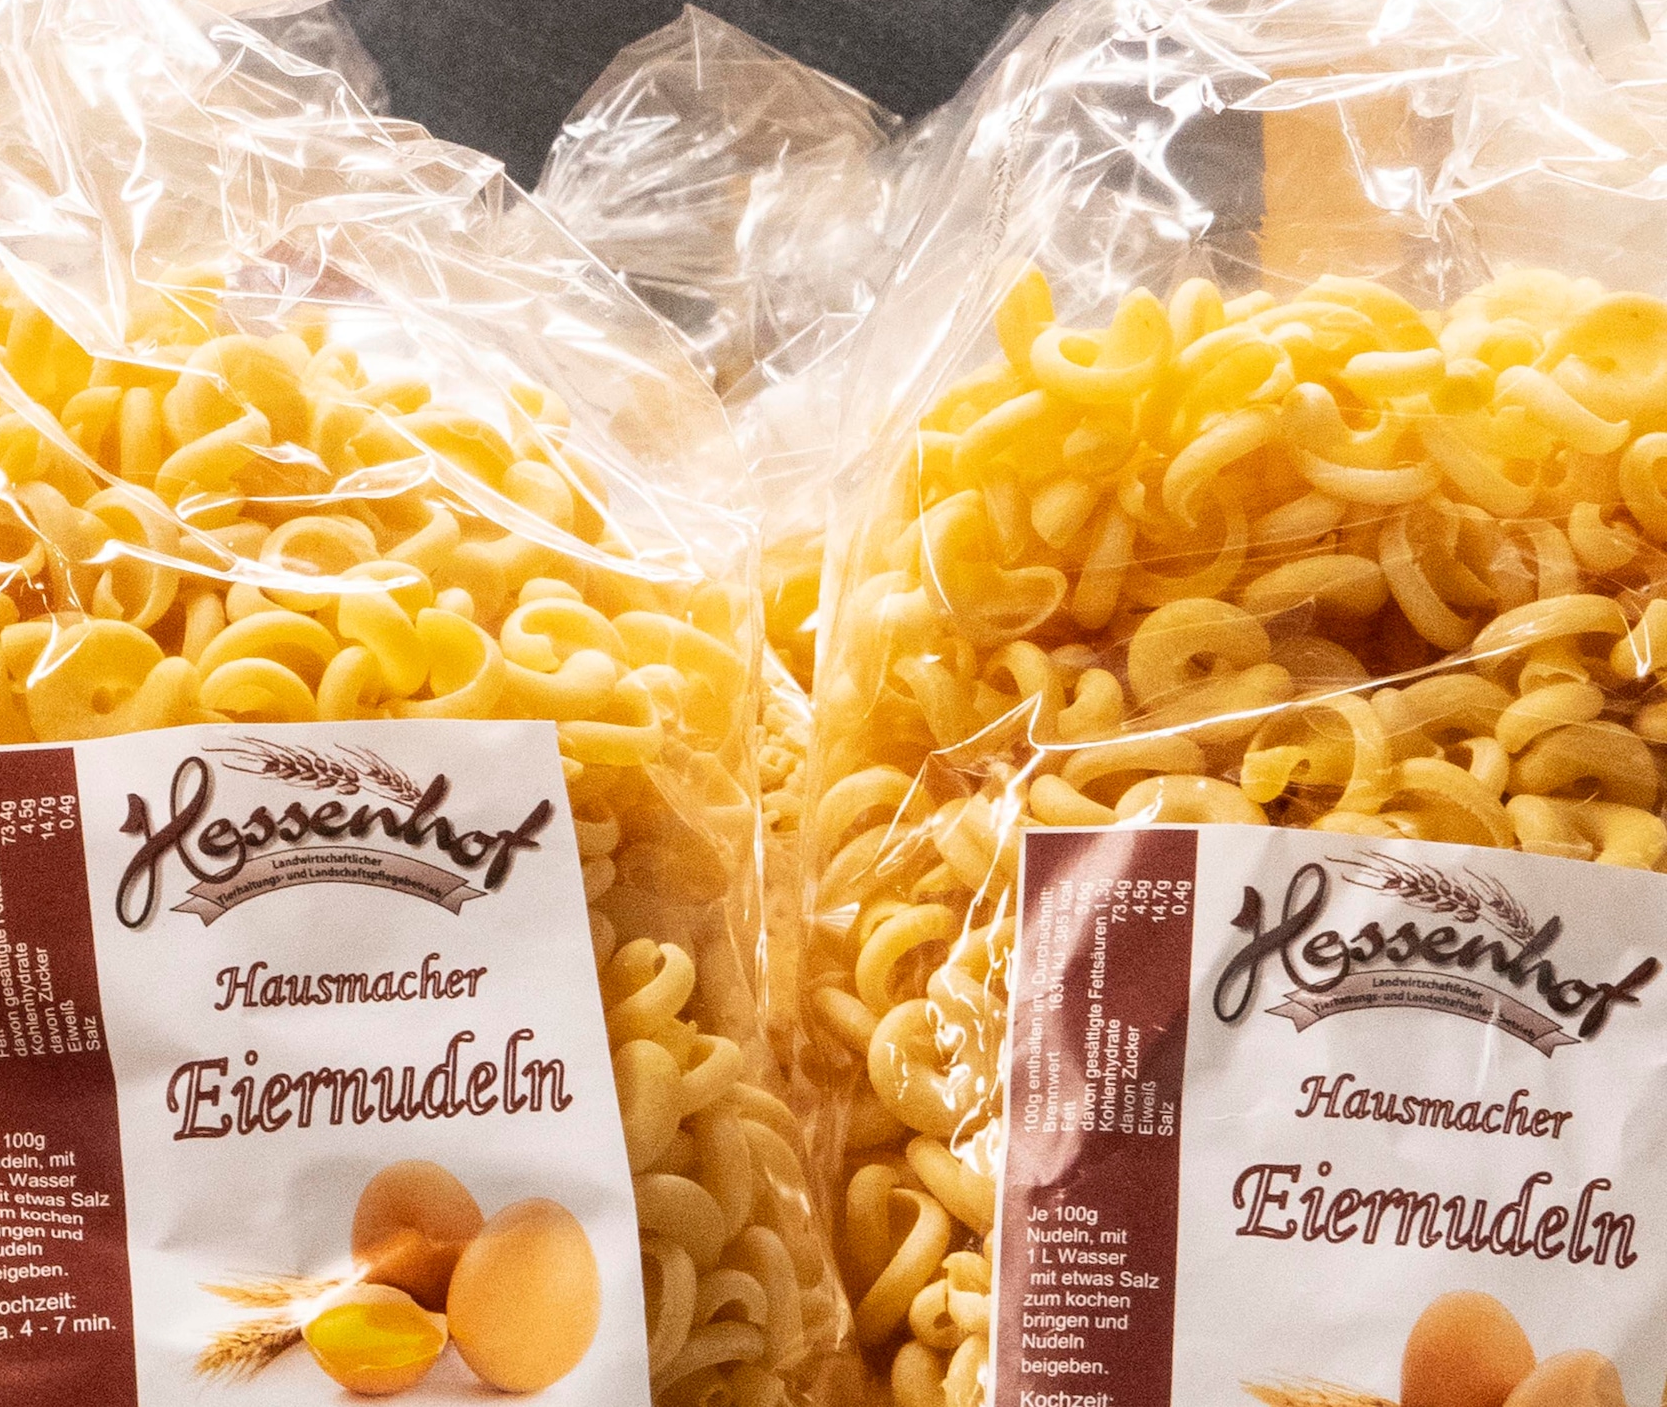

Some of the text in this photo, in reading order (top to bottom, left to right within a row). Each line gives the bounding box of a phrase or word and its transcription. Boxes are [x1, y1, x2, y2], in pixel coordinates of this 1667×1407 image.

[115, 755, 554, 929] Hessenhof
[272, 853, 383, 869] Landwirtschaftlicher
[286, 870, 308, 880] und
[1212, 862, 1662, 1039] Hessenhof
[35, 947, 54, 1002] Zucker
[213, 952, 488, 1011] Hausmacher
[16, 942, 46, 1055] Kohlenhydrate
[8, 1011, 28, 1056] davon
[45, 1008, 64, 1054] davon
[60, 999, 83, 1053] Eiweiß
[83, 1016, 101, 1051] Salz
[1122, 1025, 1140, 1080] Zucker
[167, 1028, 574, 1142] Eiernudeln
[1099, 1019, 1120, 1132] Kohlenhydrate
[1120, 1084, 1136, 1134] davon
[1295, 1072, 1573, 1140] Hausmacher
[1158, 1102, 1174, 1136] Salz
[3, 1132, 46, 1151] 100g
[49, 1151, 75, 1167] mit
[9, 1173, 77, 1188] Wasser
[14, 1193, 66, 1207] etwas
[71, 1191, 110, 1208] Salz
[20, 1208, 83, 1225] kochen
[1027, 1206, 1098, 1226] Je 100g
[1232, 1160, 1638, 1269] Eiernudeln
[51, 1228, 83, 1241] und
[1027, 1227, 1127, 1245] Nudeln, mit
[1028, 1248, 1127, 1265] 1 L Wasser
[1030, 1270, 1159, 1289] mit etwas Salz
[1023, 1291, 1130, 1308] zum kochen
[20, 1319, 33, 1337] 4
[54, 1316, 66, 1334] 7
[73, 1314, 116, 1332] min.
[1023, 1312, 1128, 1331] bringen und
[1022, 1333, 1084, 1349] Nudeln
[1021, 1358, 1109, 1377] beigeben.
